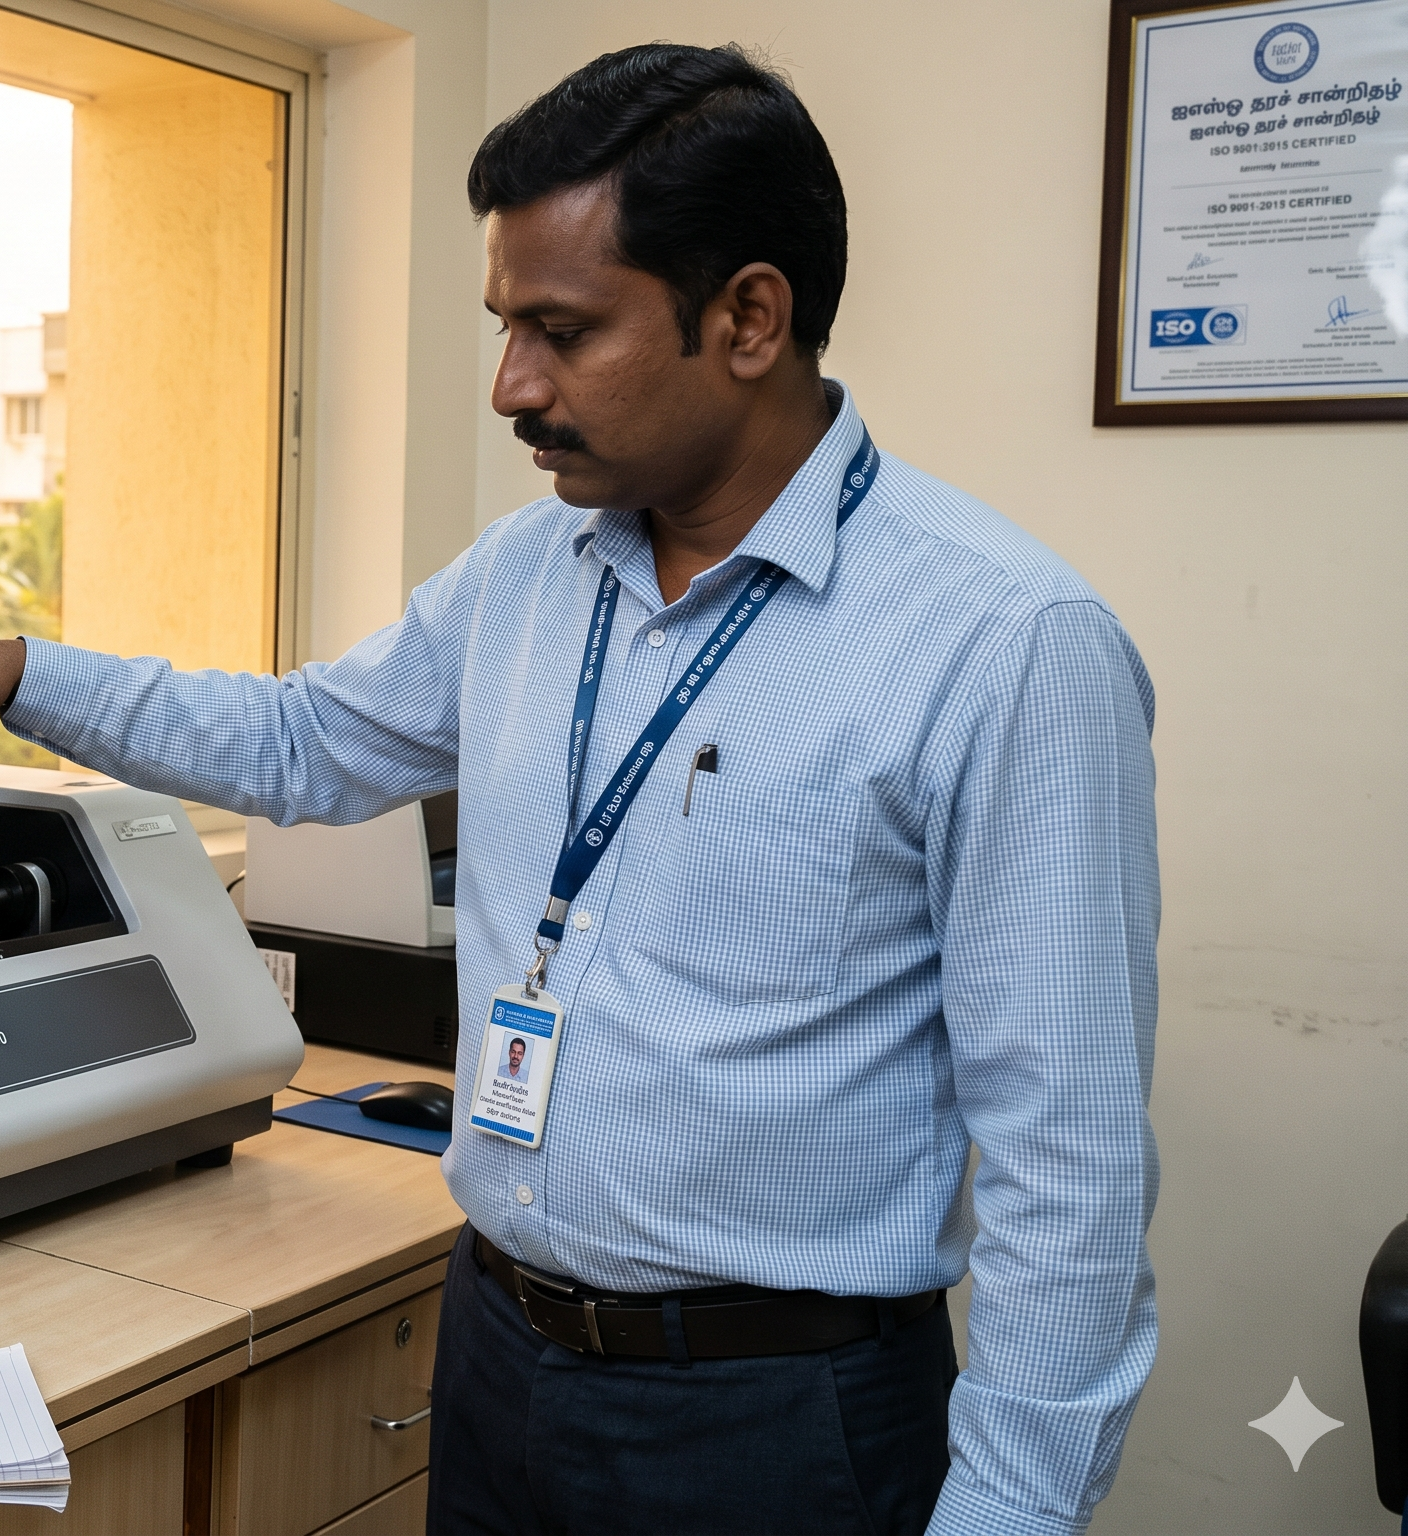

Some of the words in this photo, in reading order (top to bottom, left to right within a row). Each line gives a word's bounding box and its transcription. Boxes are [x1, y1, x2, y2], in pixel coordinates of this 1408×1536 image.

[1249, 89, 1293, 115] தரச்
[1297, 77, 1403, 105] சான்றிதழ்
[1292, 105, 1381, 128] சான்றிதழ்
[1210, 145, 1230, 156] ISO
[1291, 133, 1357, 149] CERTIFIED
[1207, 203, 1227, 215] ISO
[1288, 194, 1352, 209] CERTIFIED
[1155, 319, 1196, 337] ISO
